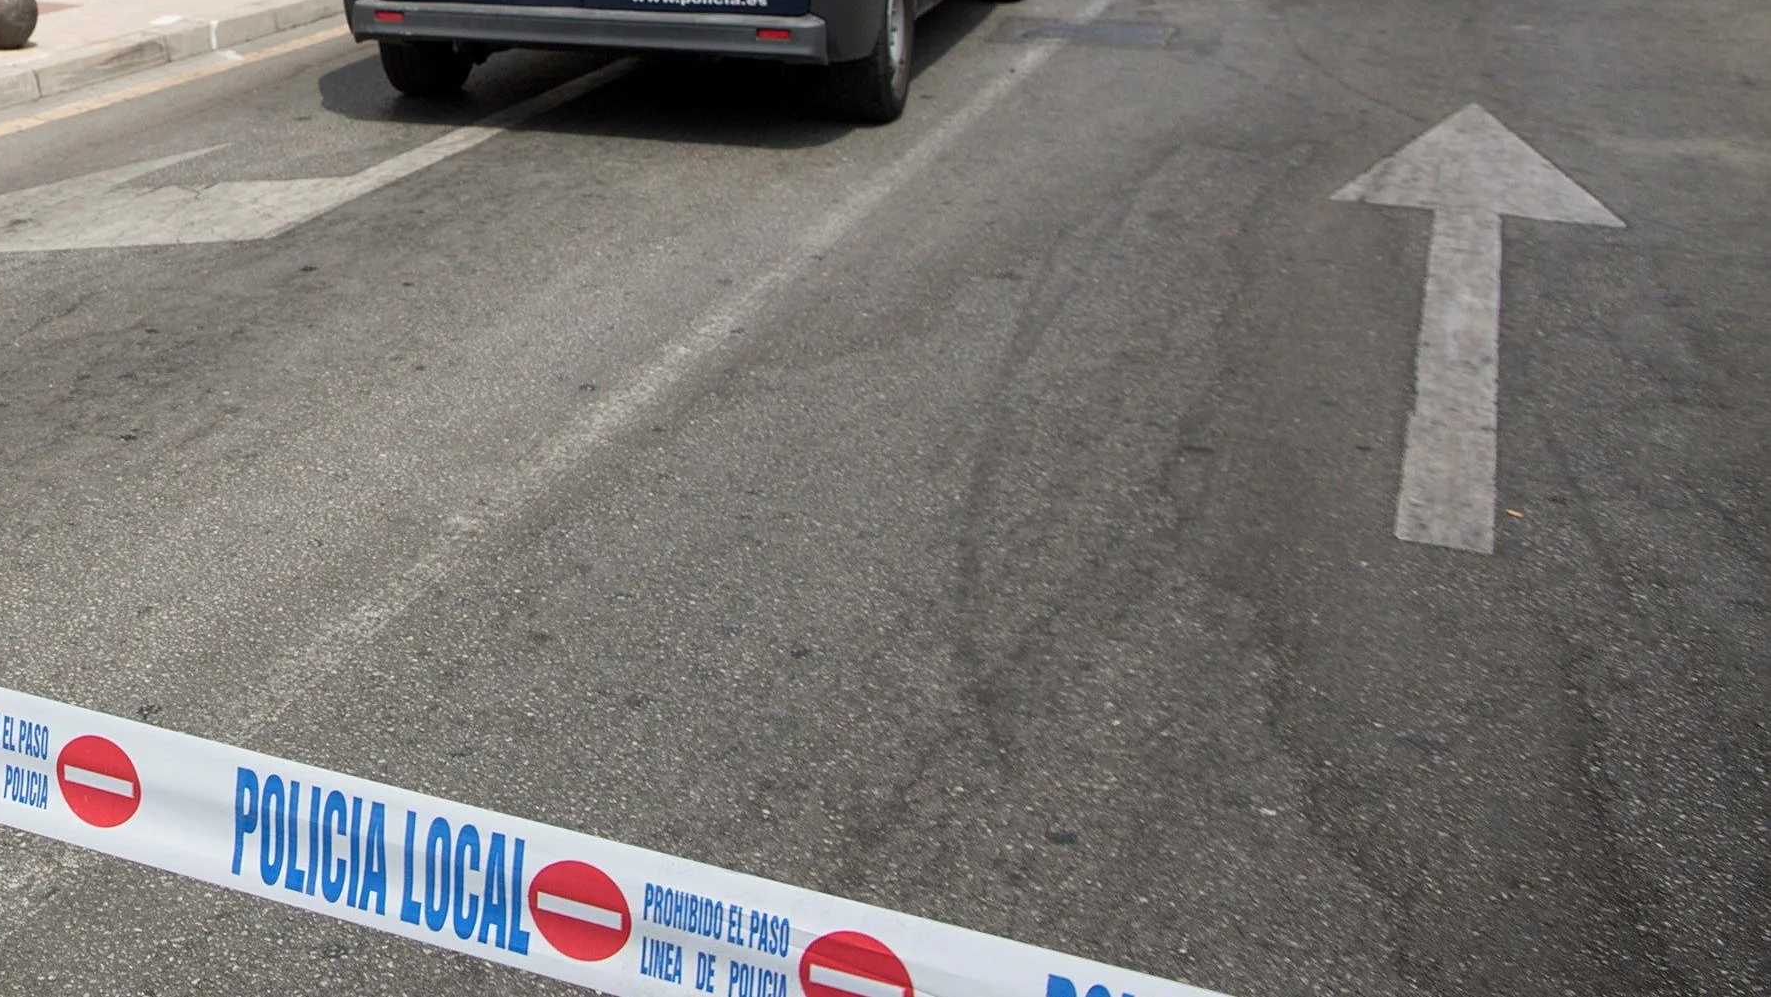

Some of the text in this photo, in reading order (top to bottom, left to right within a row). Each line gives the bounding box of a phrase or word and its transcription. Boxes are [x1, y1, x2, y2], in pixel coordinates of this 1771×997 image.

[2, 716, 17, 752] EL
[18, 719, 49, 761] PASO
[3, 764, 48, 811] POLICIA
[231, 767, 531, 956] POLICIA LOCAL
[643, 882, 790, 958] PROHIBIDO EL PASO
[640, 936, 788, 997] LINEA DE POLICIA
